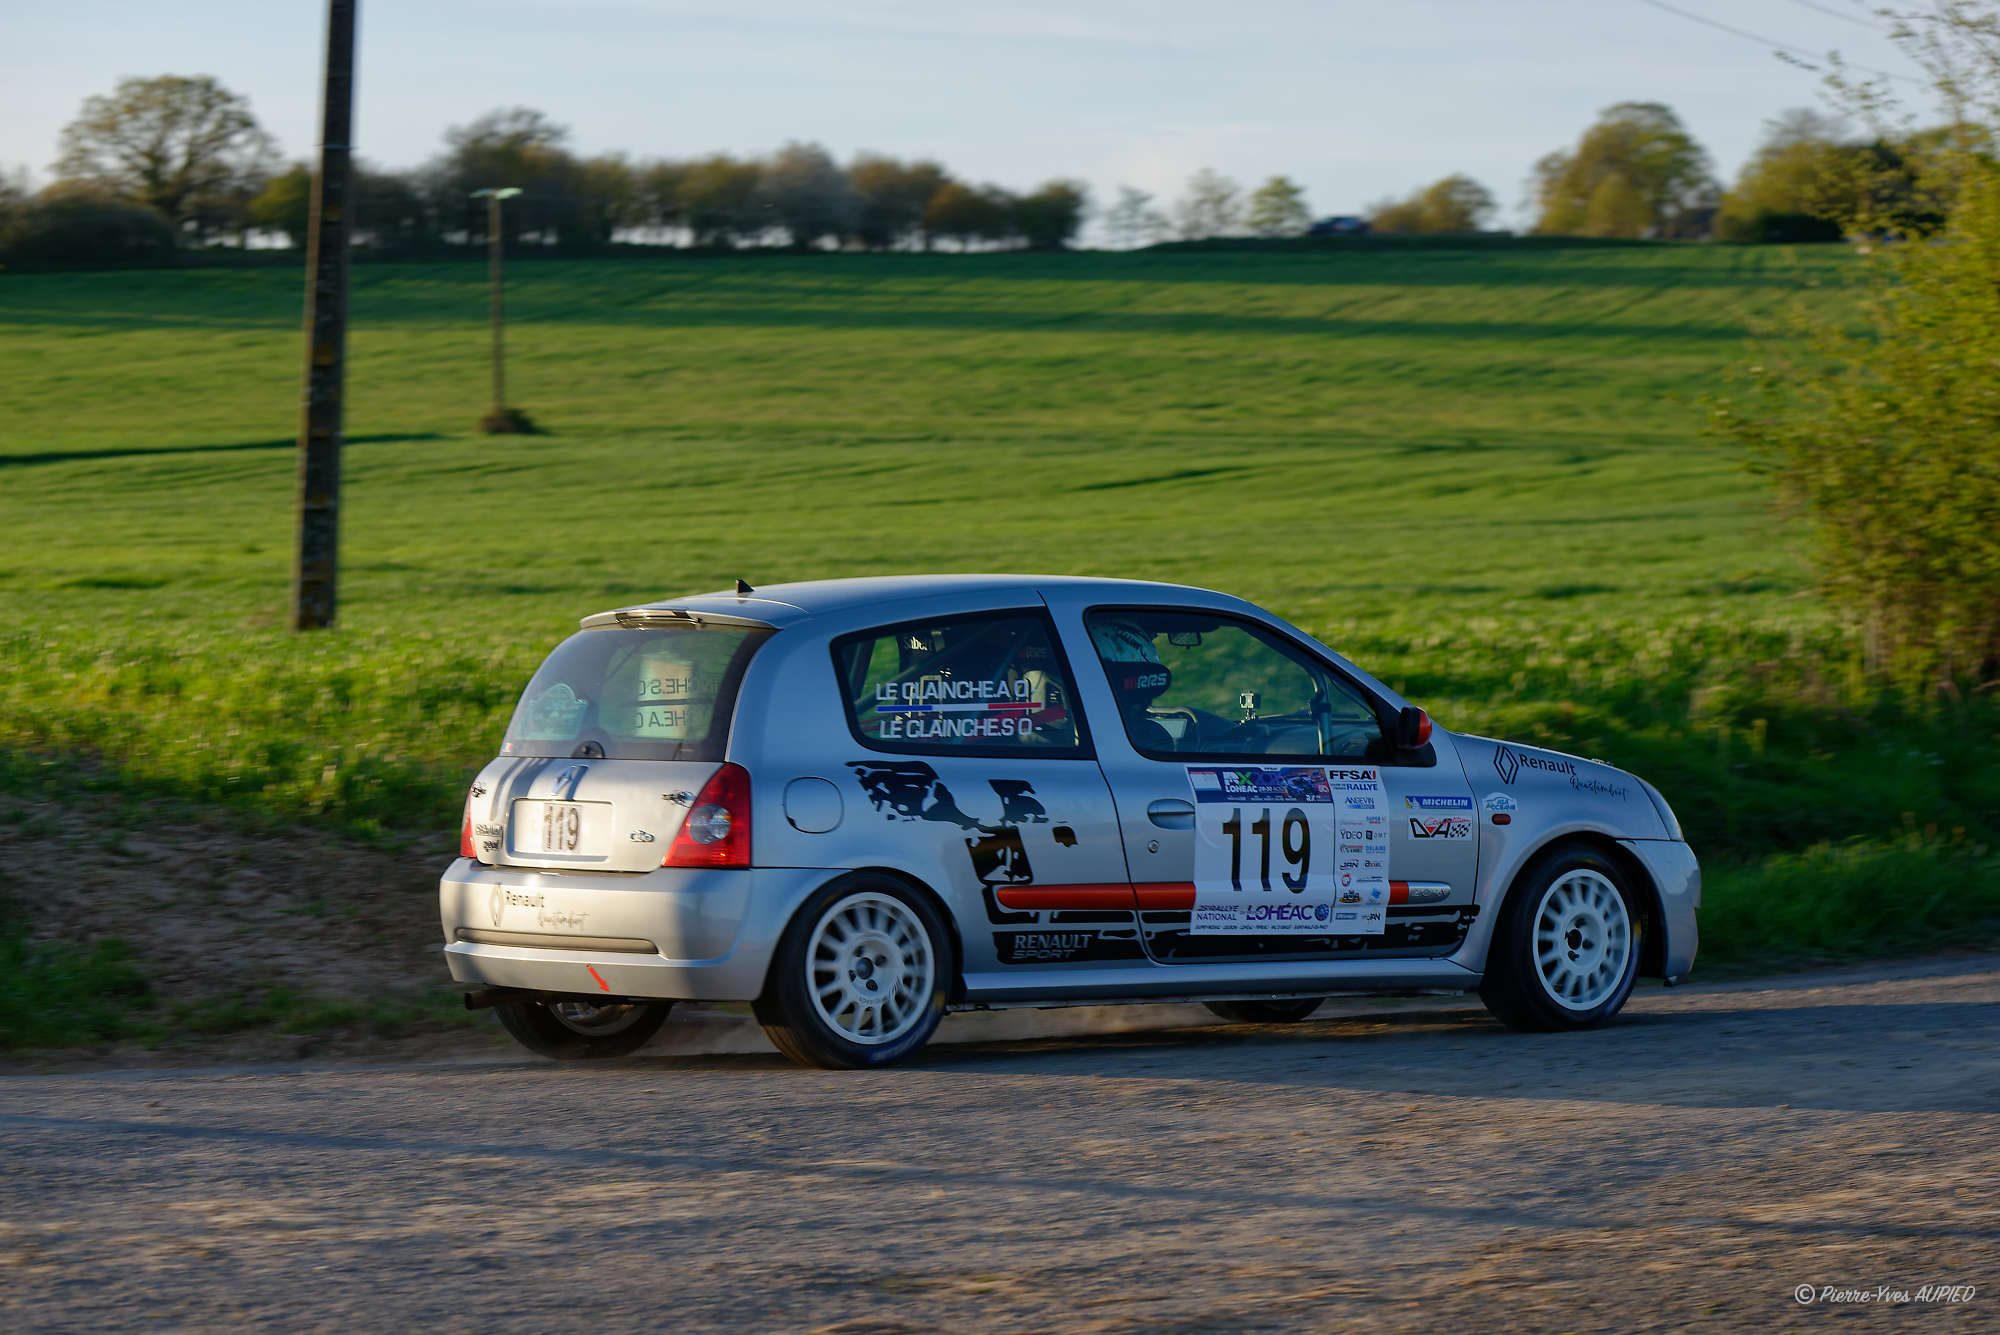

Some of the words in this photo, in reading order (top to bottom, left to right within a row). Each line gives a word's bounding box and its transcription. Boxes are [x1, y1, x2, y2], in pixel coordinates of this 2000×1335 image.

[875, 682, 898, 701] LE
[879, 719, 903, 739] LE
[1519, 753, 1577, 776] Renault
[1346, 783, 1378, 791] RALLYE
[1422, 798, 1468, 807] MICHELIN
[544, 806, 579, 851] 119
[1222, 807, 1311, 894] 119
[1196, 913, 1237, 921] NATIONAL
[1246, 902, 1314, 921] LOHÉAC
[1013, 933, 1092, 949] RENAULT
[1011, 949, 1075, 959] SPORT
